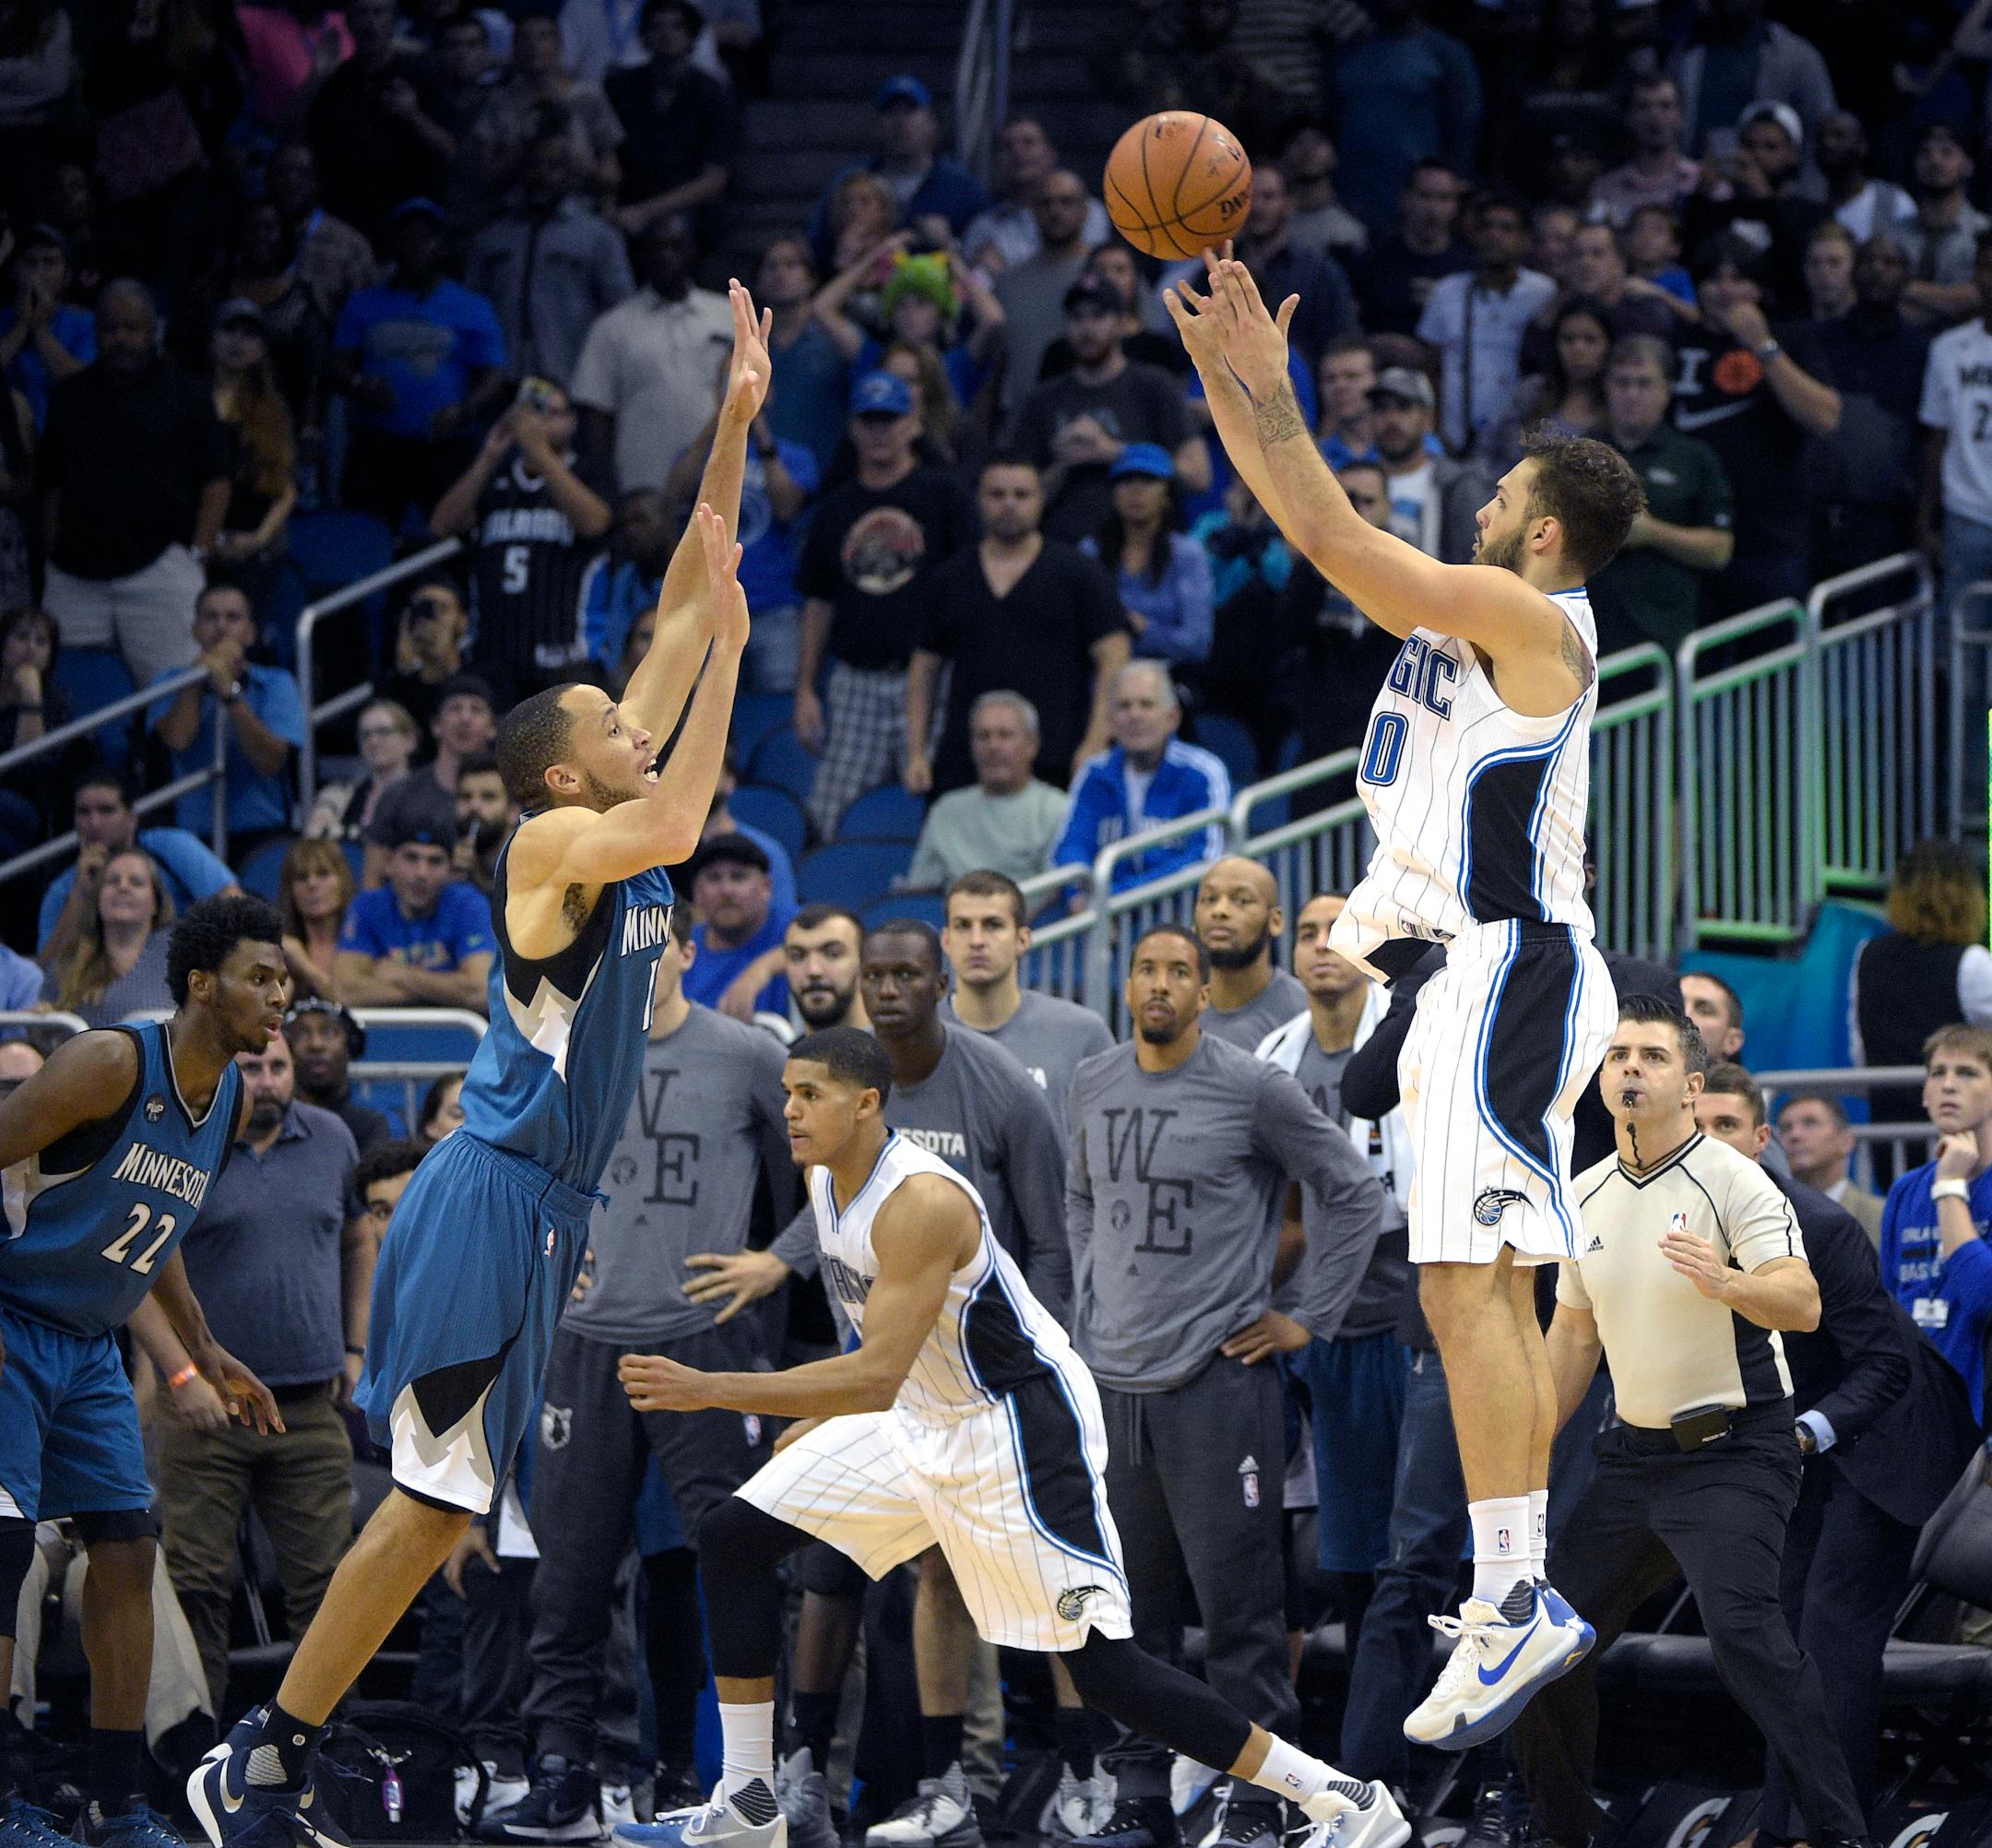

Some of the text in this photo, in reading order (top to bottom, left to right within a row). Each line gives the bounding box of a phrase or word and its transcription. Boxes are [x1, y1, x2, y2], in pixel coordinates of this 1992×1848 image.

[502, 545, 530, 594] 5
[1388, 634, 1459, 722] GIC
[1360, 710, 1409, 788] 0
[641, 957, 662, 1033] 1
[100, 1202, 177, 1275] 22
